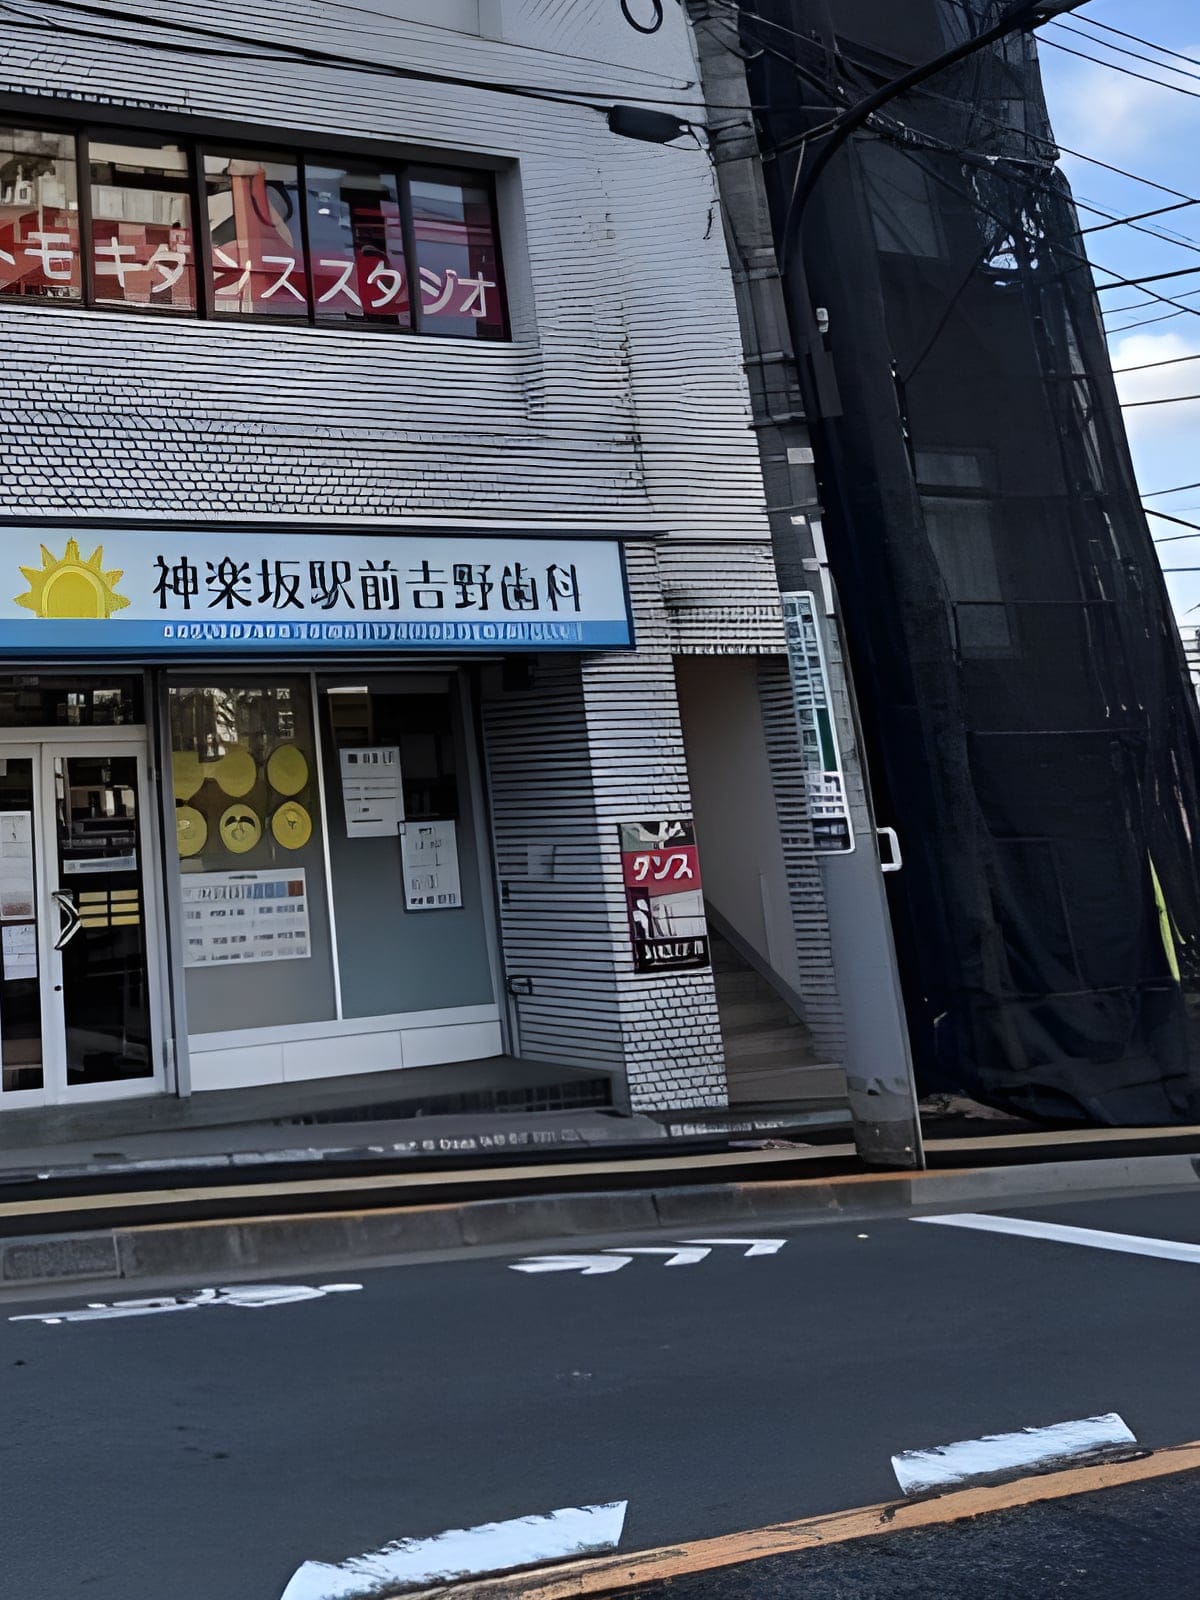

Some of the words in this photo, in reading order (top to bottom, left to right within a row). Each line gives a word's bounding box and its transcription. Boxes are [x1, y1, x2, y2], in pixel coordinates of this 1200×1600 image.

[152, 554, 581, 612] 神楽坂駅前吉野歯科
